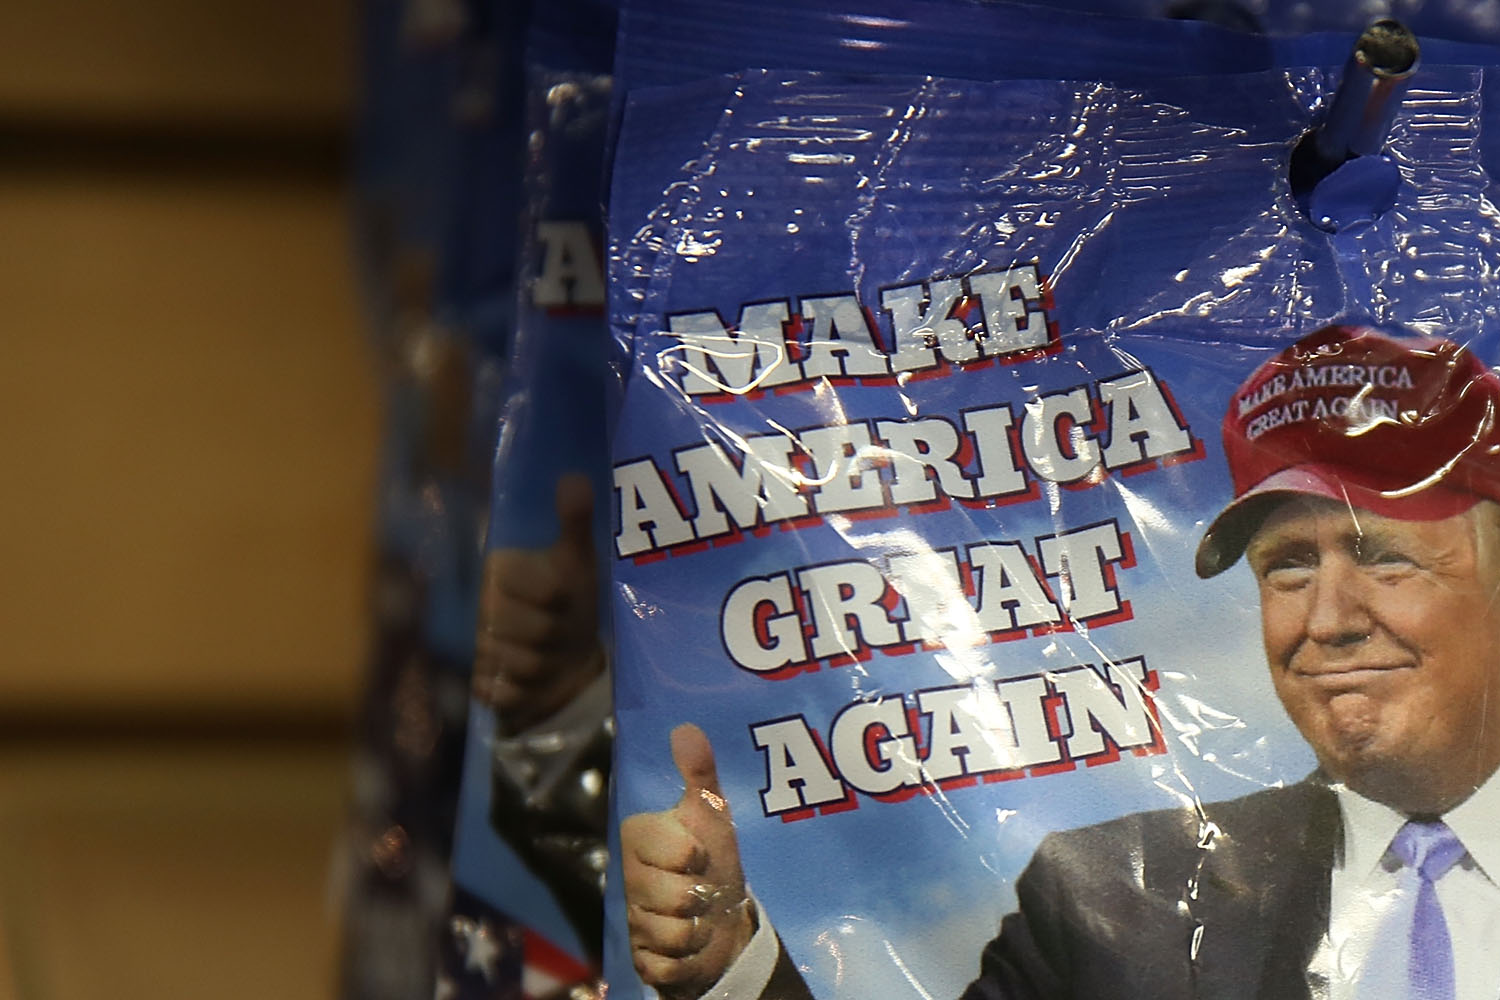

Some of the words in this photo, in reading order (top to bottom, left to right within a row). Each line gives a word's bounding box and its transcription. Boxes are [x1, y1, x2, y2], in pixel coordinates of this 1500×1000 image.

[668, 263, 1058, 399] MAKE
[1238, 374, 1286, 418] MAKE
[1288, 365, 1414, 389] AMERICA
[613, 367, 1203, 562] AMERICA
[1246, 399, 1309, 441] GREAT
[749, 656, 1165, 820] AGAIN
